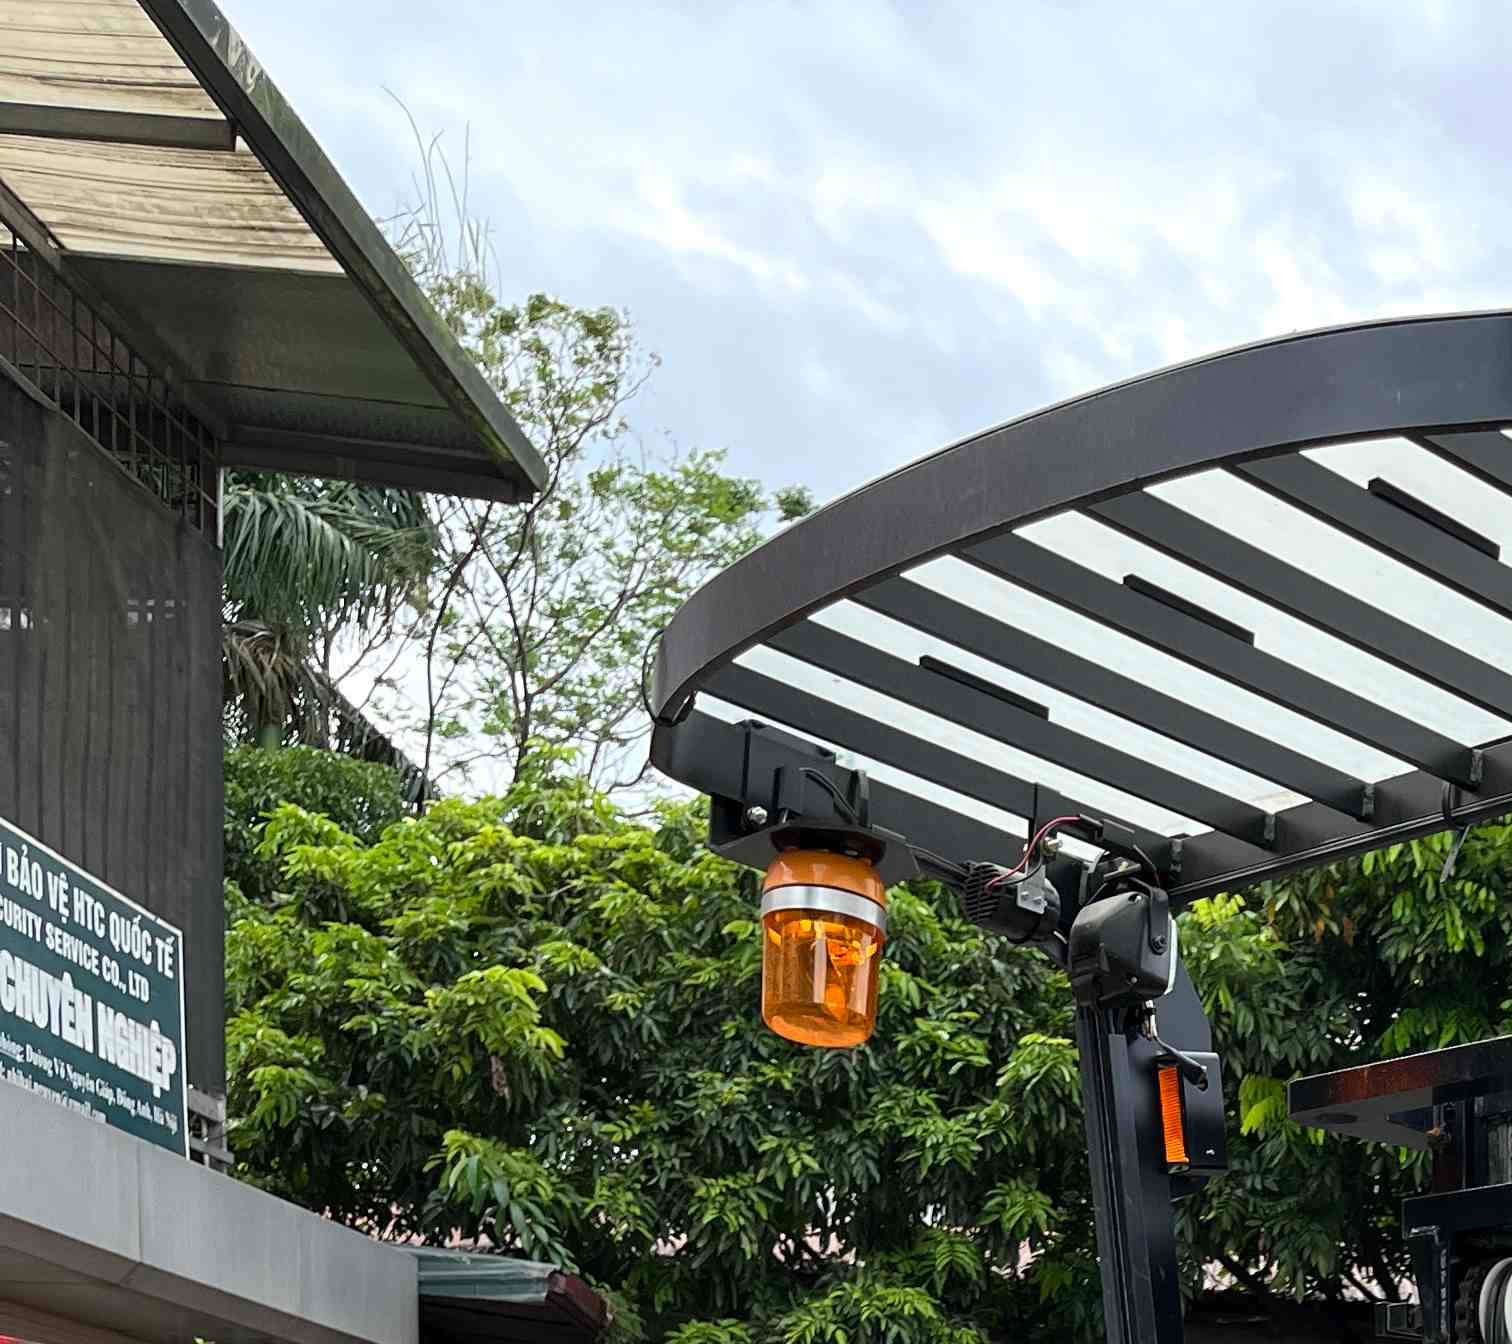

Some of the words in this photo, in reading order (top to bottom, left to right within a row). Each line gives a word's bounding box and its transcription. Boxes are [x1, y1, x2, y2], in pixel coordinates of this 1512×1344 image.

[6, 844, 43, 900] BẢO
[47, 873, 69, 924] VỆ
[73, 887, 105, 938] HTC
[109, 914, 152, 965] QUỐC
[155, 936, 175, 979] TẾ
[45, 922, 100, 976] SERVICE
[128, 970, 149, 1003] LTD
[0, 950, 94, 1054] CHUYÊN
[97, 1001, 177, 1098] NGHIỆP
